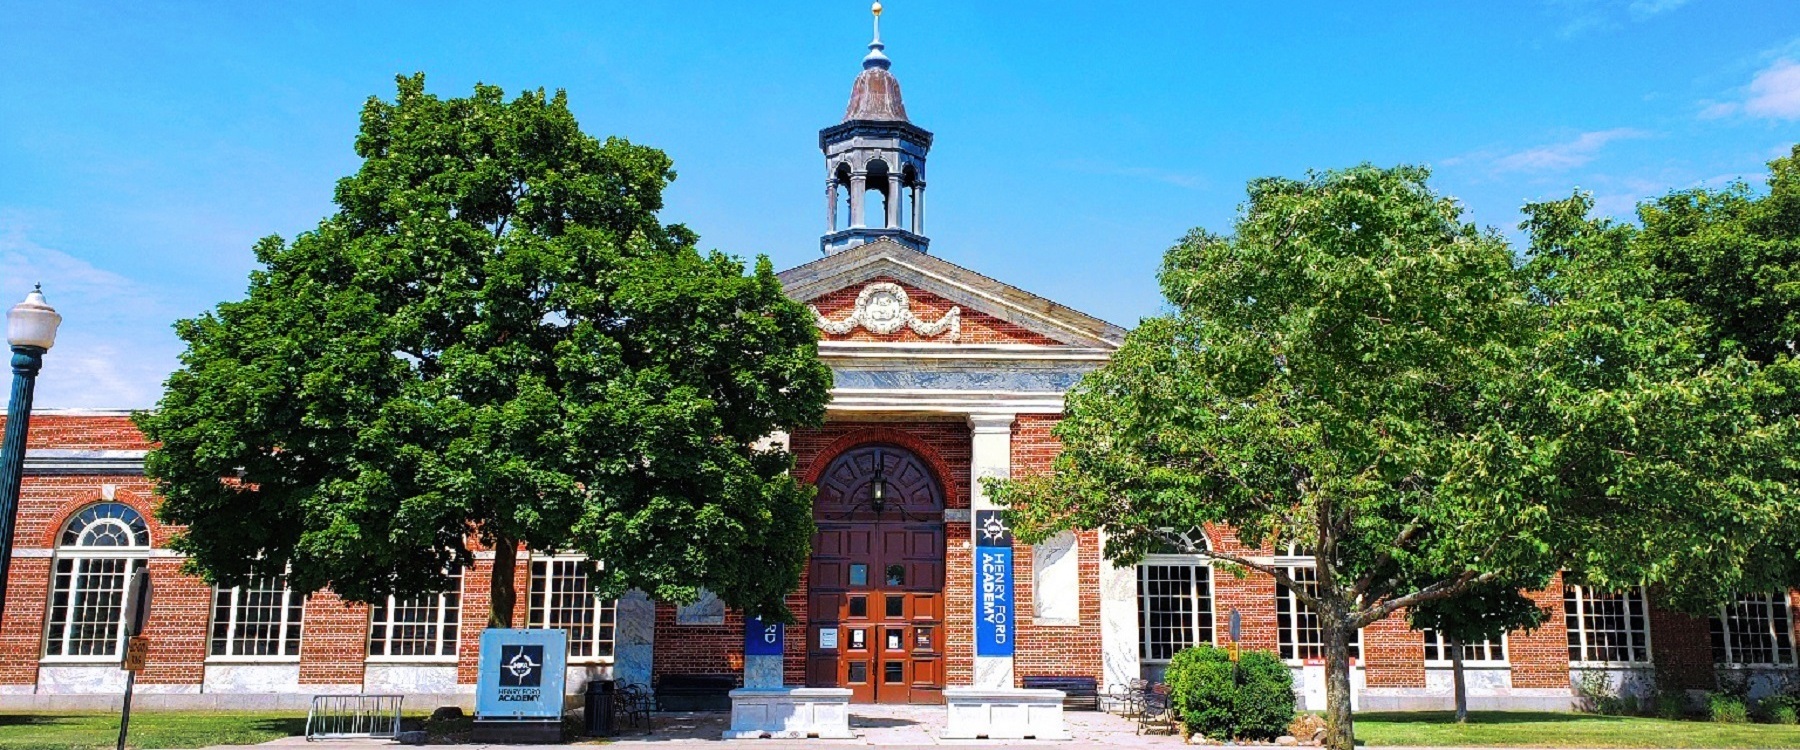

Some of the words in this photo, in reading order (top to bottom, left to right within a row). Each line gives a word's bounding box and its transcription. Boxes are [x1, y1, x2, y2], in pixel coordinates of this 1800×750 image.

[982, 552, 995, 624] ACADEMY
[994, 553, 1005, 602] HENRY
[994, 605, 1006, 644] FORD
[498, 694, 541, 702] ACADEMY
